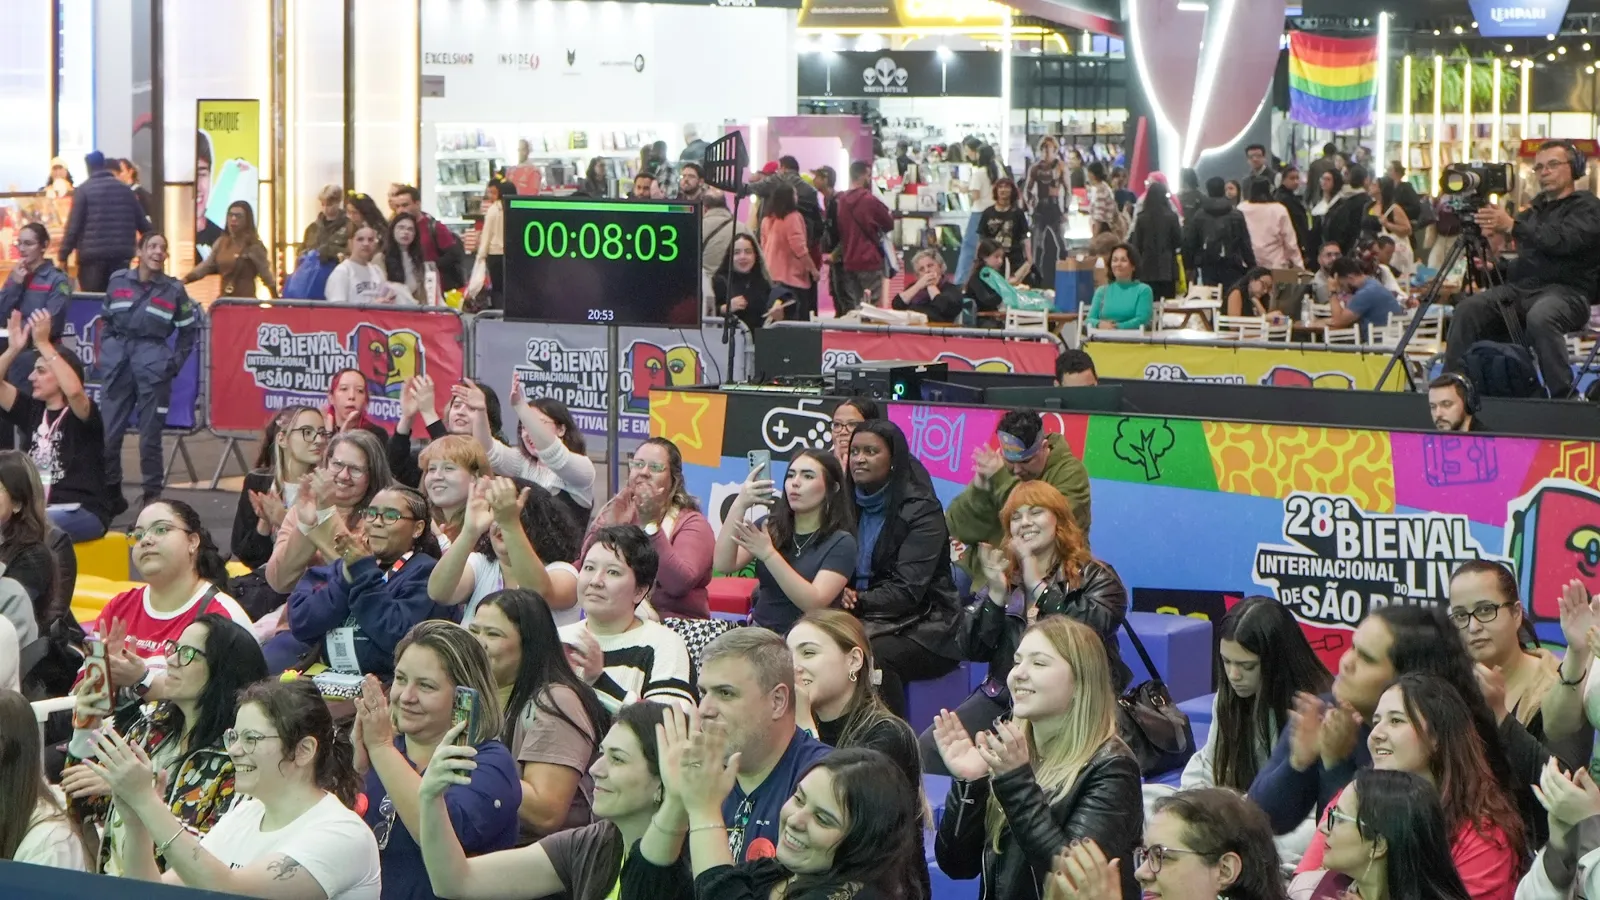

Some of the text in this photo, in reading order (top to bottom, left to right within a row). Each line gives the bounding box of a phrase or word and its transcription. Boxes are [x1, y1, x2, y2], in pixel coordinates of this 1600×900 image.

[425, 52, 474, 64] EXCELSIOR
[204, 111, 239, 134] HENRIQUE
[524, 221, 679, 262] 00:08:03
[588, 309, 614, 321] 20:53
[280, 335, 341, 357] BIENAL
[247, 355, 309, 368] INTERNACIONAL
[266, 367, 293, 388] SÃO
[518, 370, 580, 384] NTERNACIONAL
[582, 371, 632, 392] LIVO
[265, 395, 283, 409] UM
[1336, 518, 1476, 560] BIENAL
[1259, 554, 1460, 599] INTERNACIONAL DO LIV
[1281, 588, 1302, 606] DE
[1300, 581, 1363, 624] SÃO
